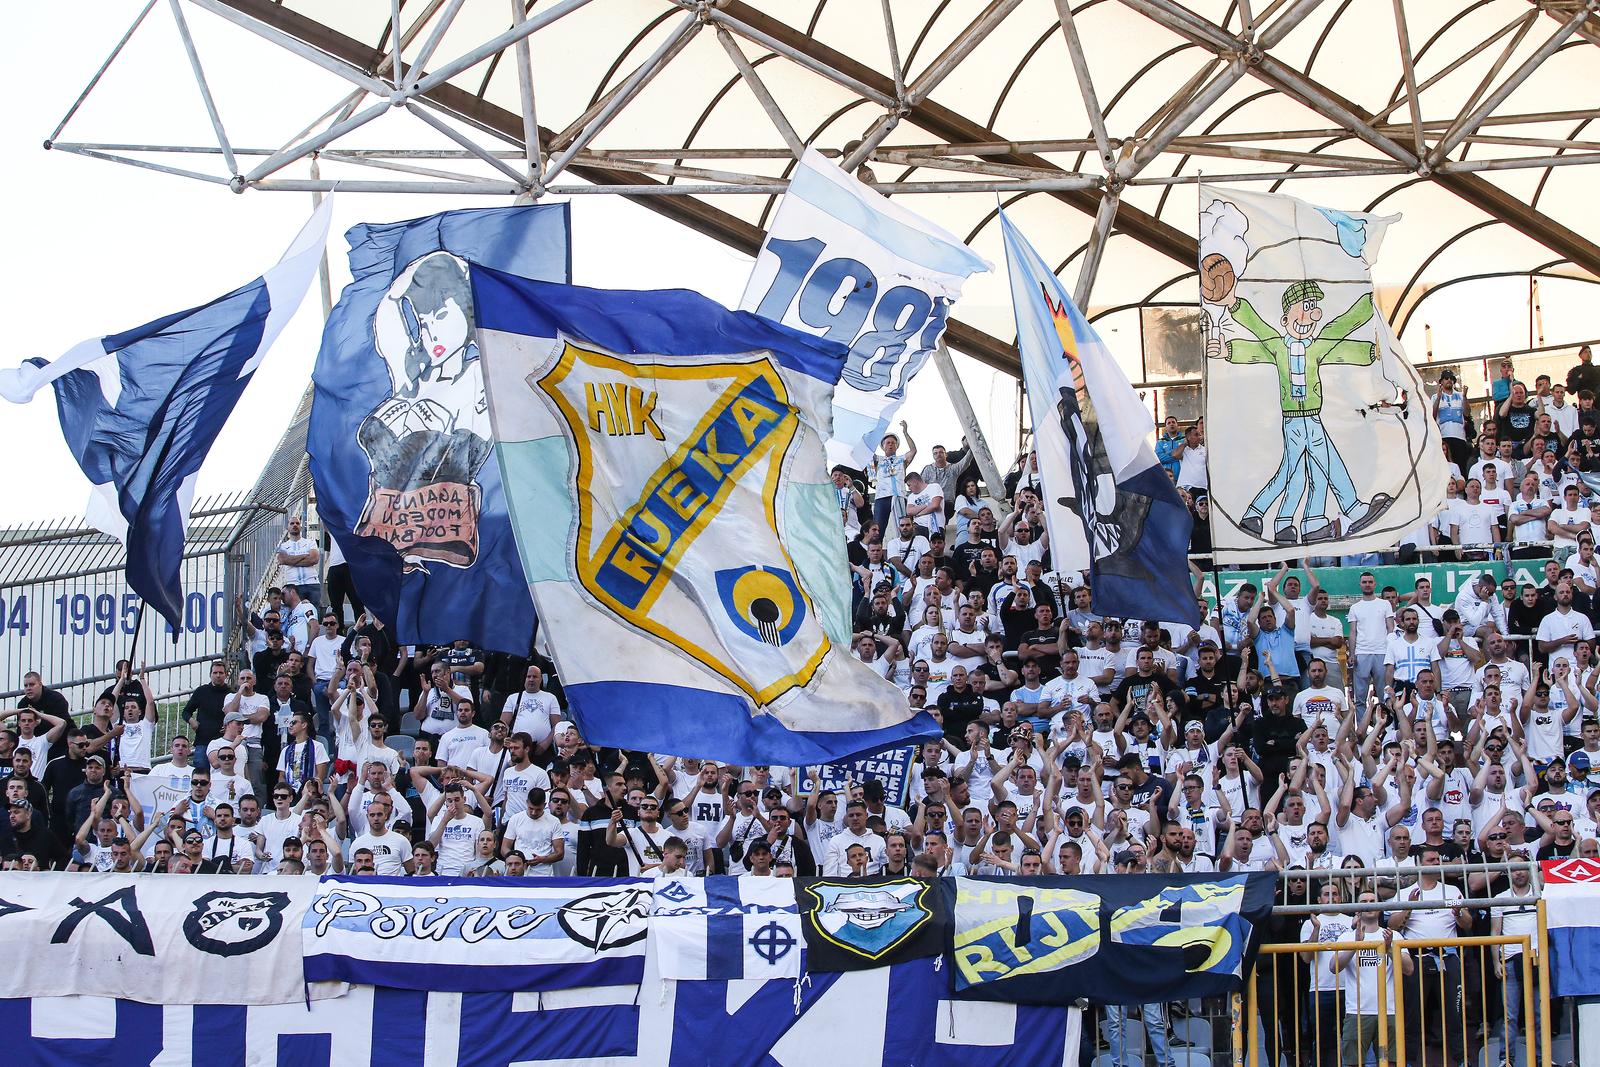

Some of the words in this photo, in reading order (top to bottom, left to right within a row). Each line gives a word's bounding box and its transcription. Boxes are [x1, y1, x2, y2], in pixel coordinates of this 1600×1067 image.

[583, 381, 666, 441] HNK
[610, 396, 781, 585] RIJEKA
[55, 592, 142, 636] 1995
[165, 591, 224, 634] 00
[1306, 704, 1334, 713] Board
[855, 760, 903, 776] YEAR
[158, 791, 179, 802] HNK
[697, 803, 722, 822] RI
[218, 900, 237, 908] NK
[957, 888, 1077, 905] HNK
[1444, 900, 1462, 908] 1986
[312, 888, 557, 944] Psine
